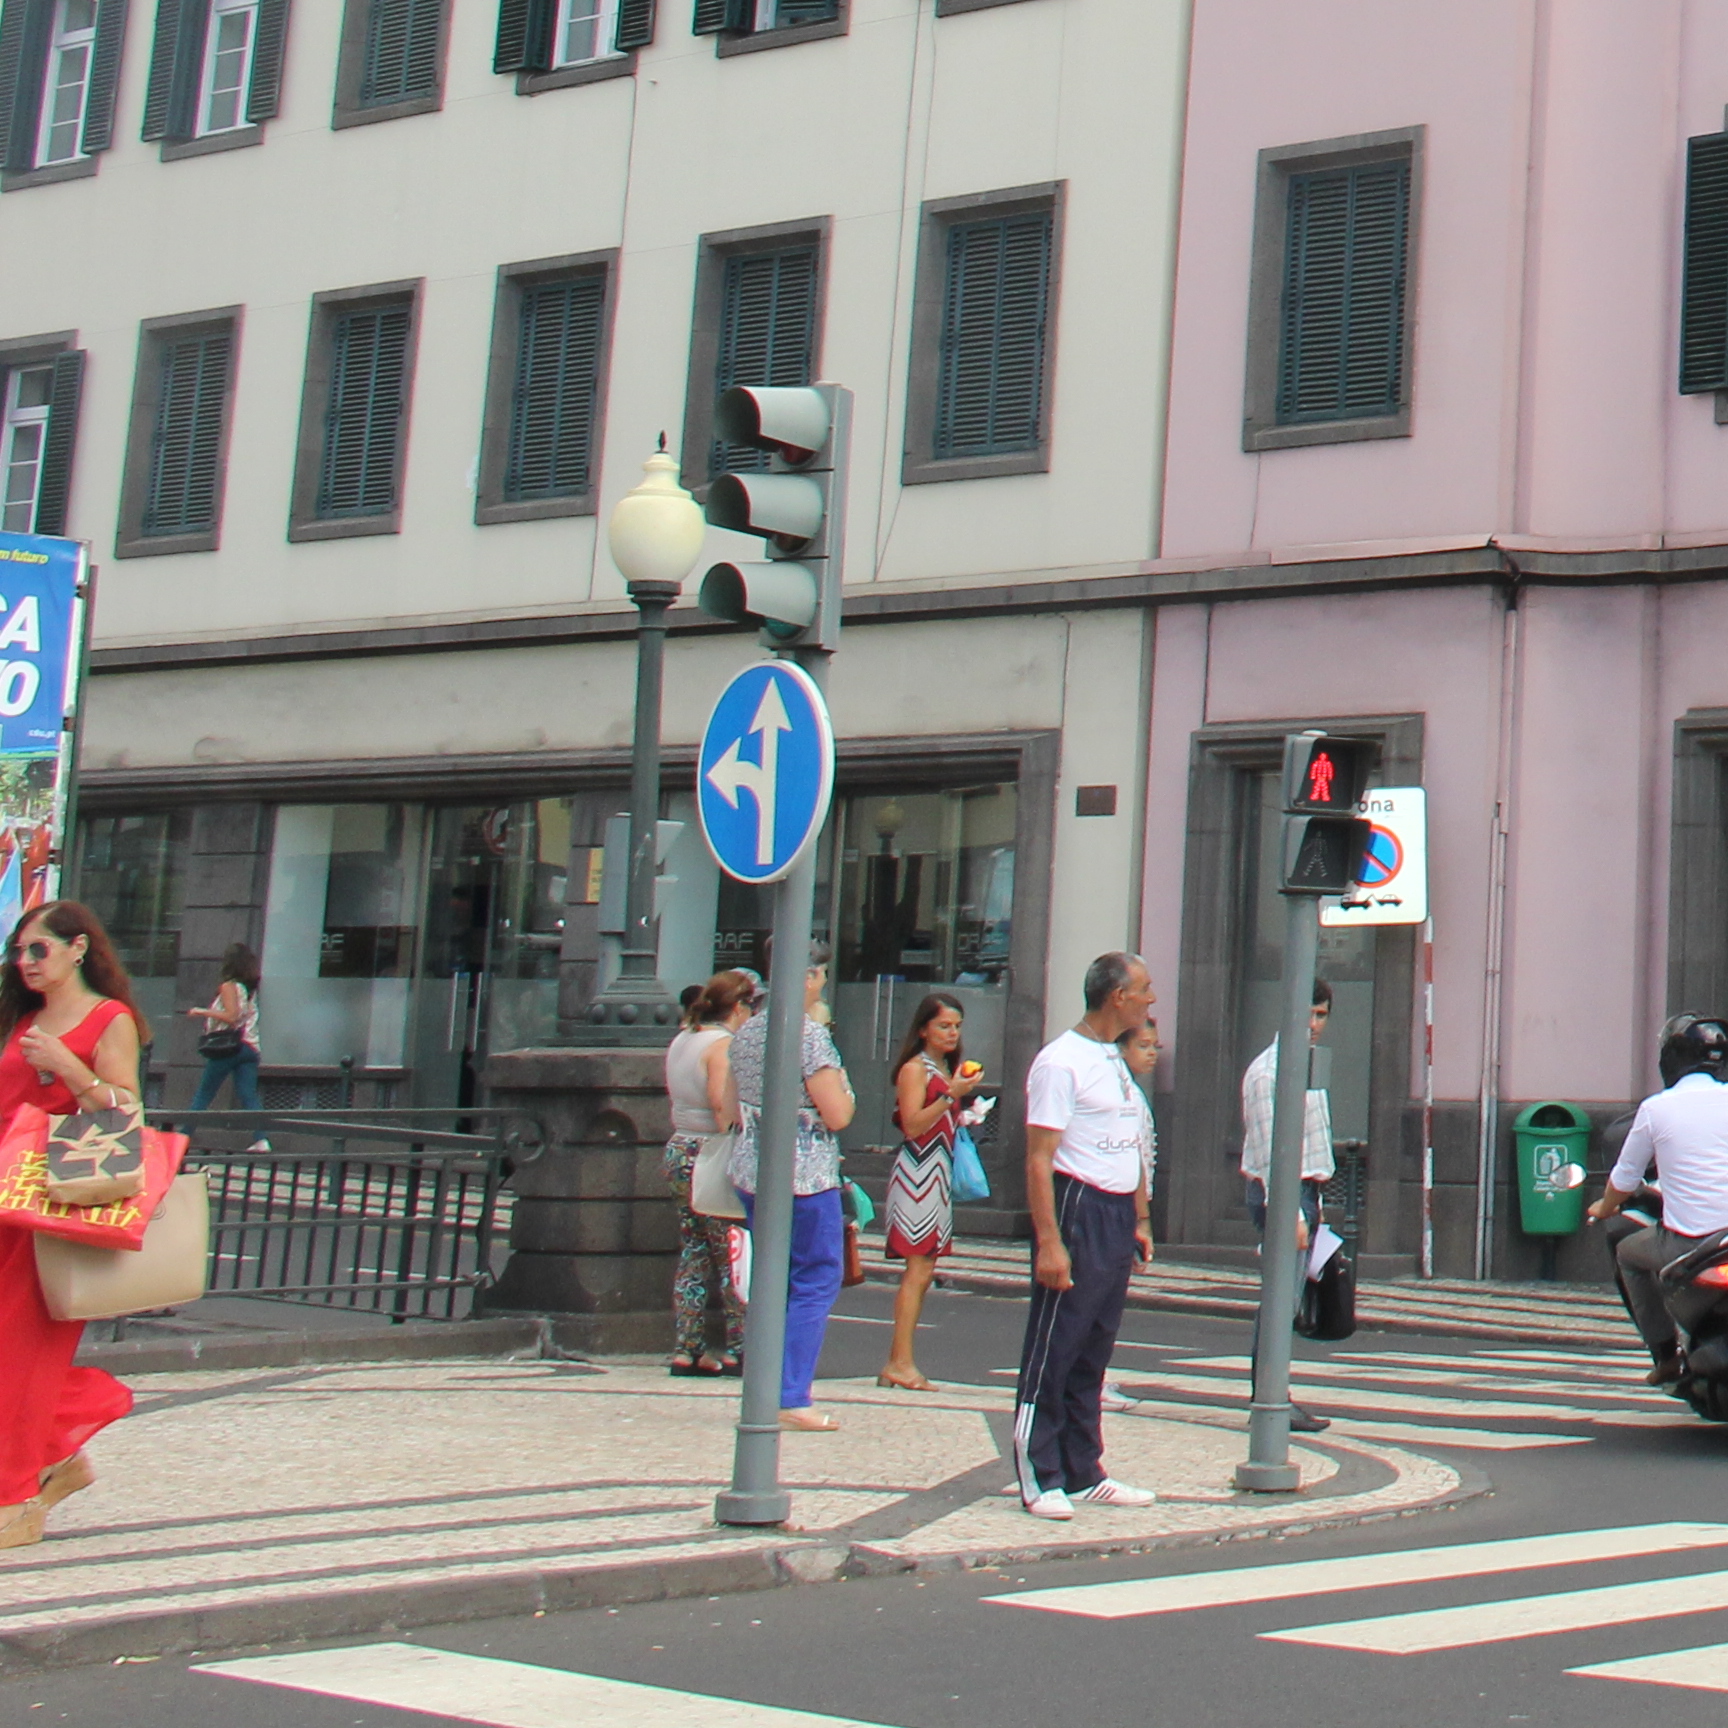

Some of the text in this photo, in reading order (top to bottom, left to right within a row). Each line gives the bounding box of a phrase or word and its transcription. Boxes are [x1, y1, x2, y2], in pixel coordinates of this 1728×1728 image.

[0, 591, 41, 652] A
[0, 658, 41, 717] O
[1358, 798, 1395, 813] ona
[714, 932, 754, 950] RAF
